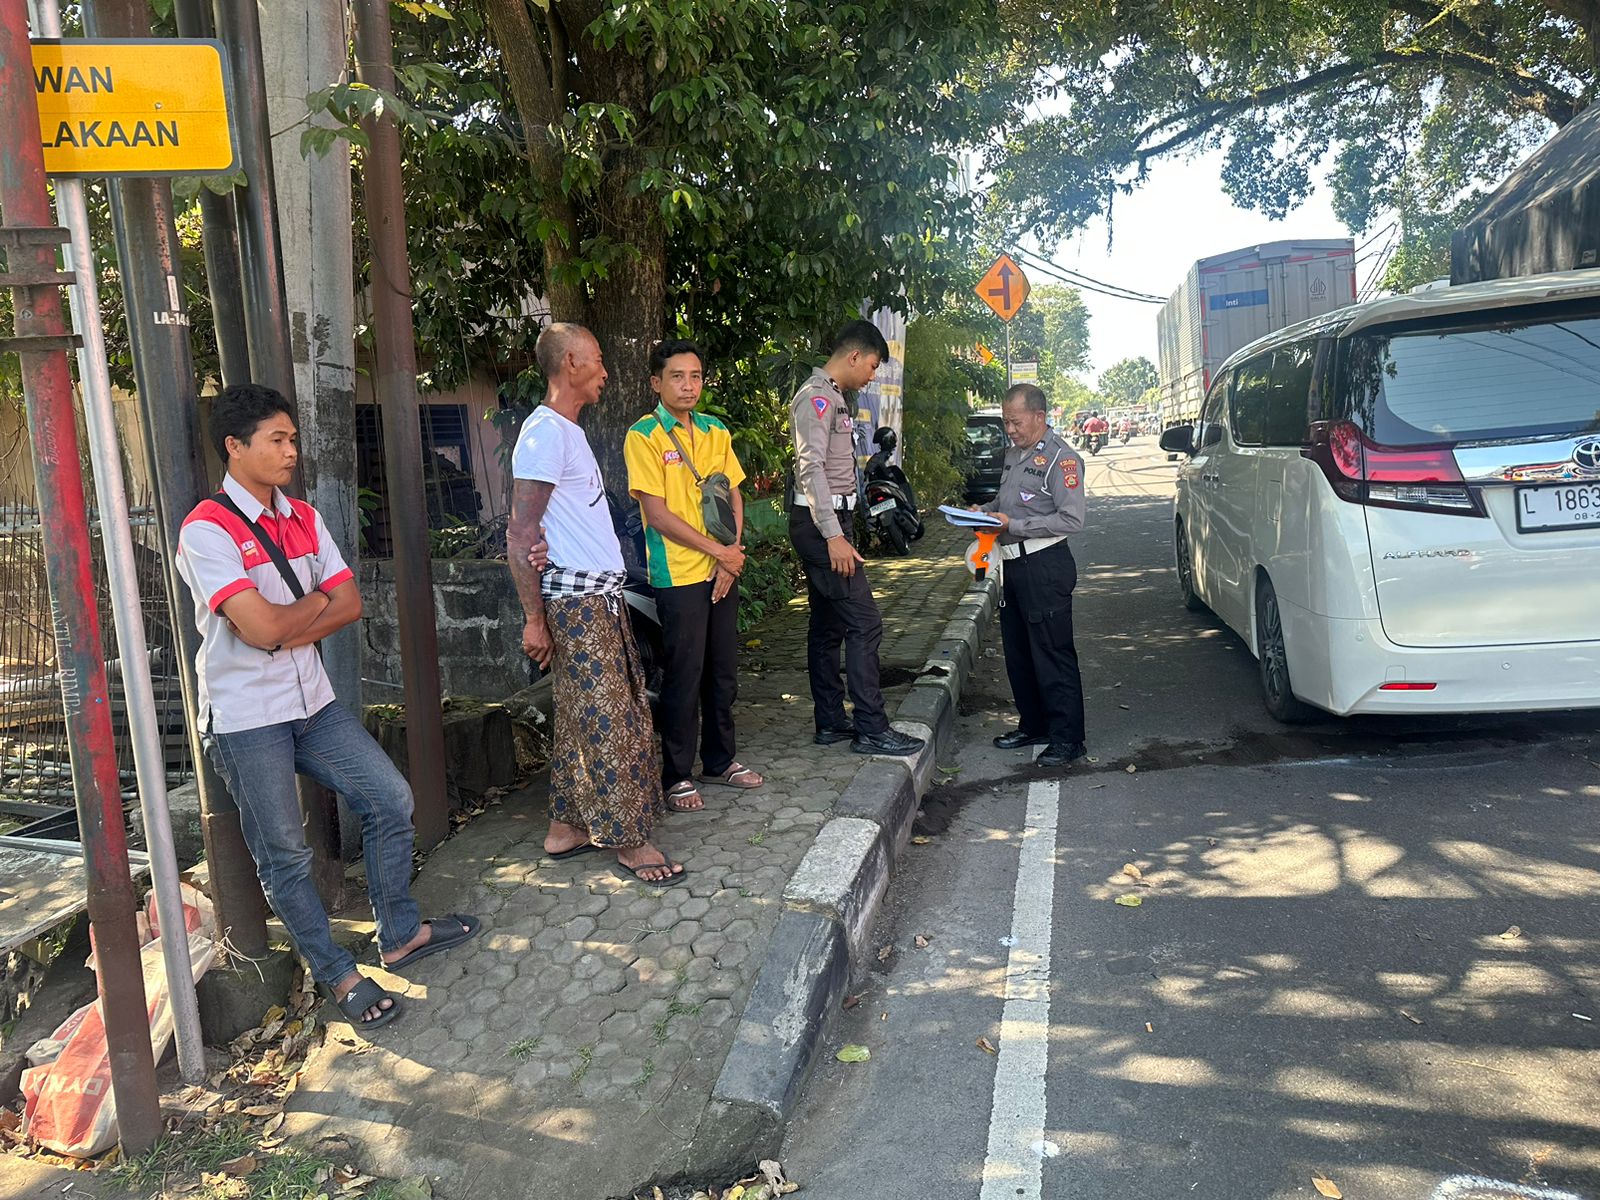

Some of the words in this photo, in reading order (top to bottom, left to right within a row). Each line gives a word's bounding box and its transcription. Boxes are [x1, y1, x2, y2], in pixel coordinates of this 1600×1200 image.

[1225, 298, 1239, 307] Inti
[1024, 466, 1047, 478] POLRI
[1524, 493, 1536, 514] L
[1554, 487, 1600, 512] 1863
[1382, 549, 1471, 560] ALPHARD
